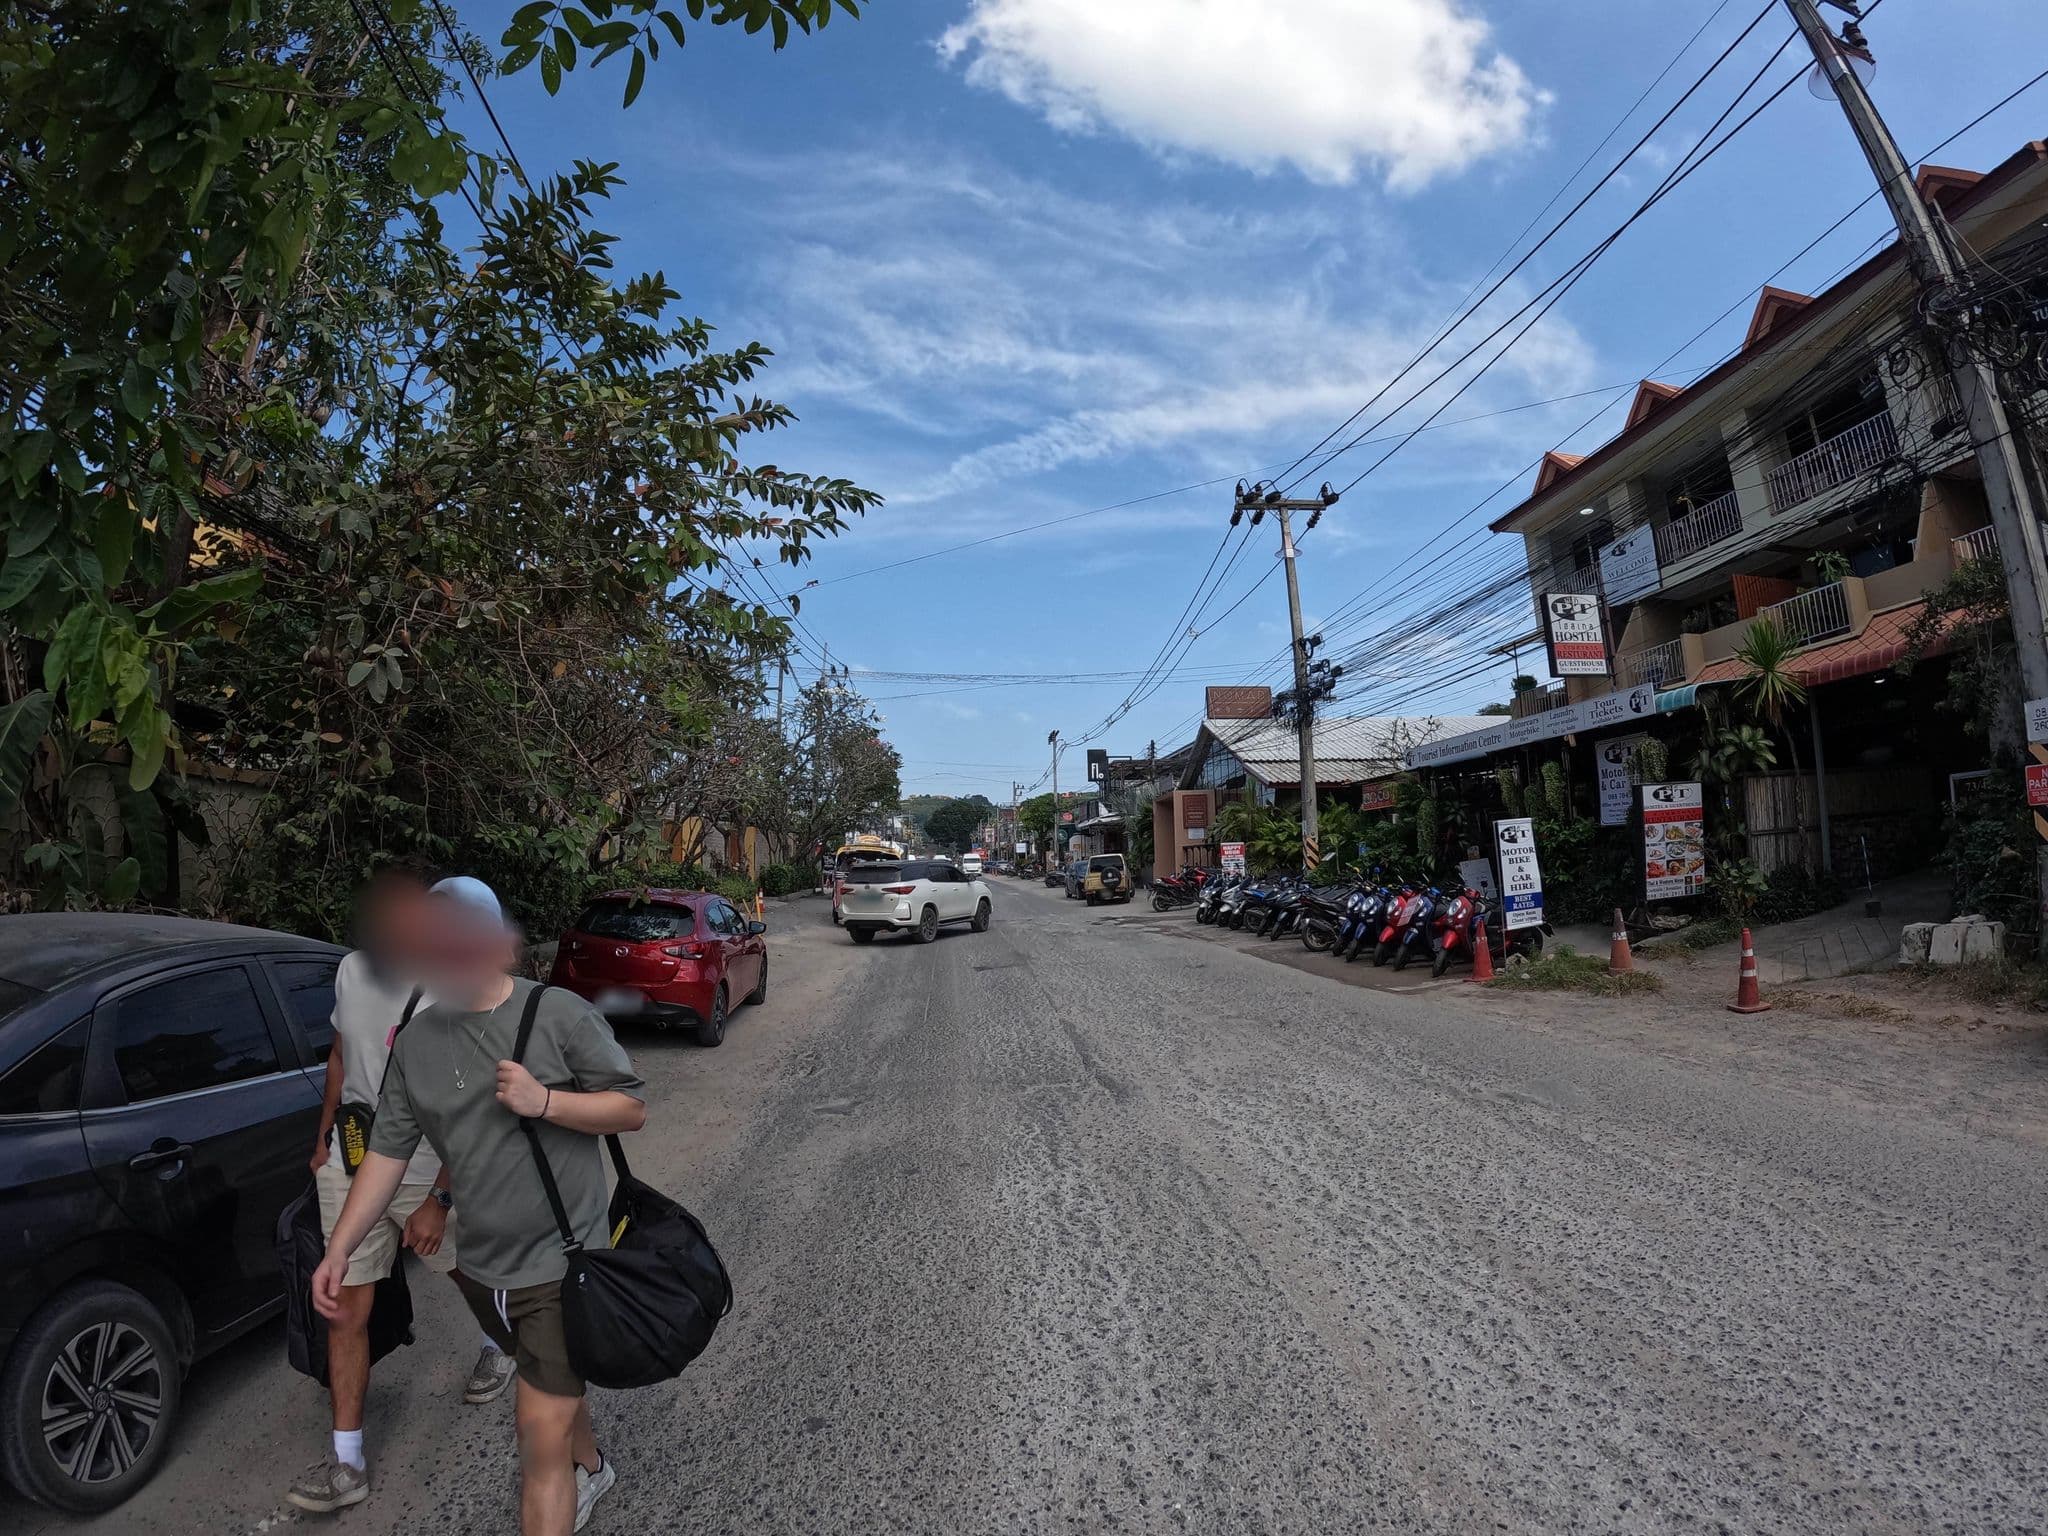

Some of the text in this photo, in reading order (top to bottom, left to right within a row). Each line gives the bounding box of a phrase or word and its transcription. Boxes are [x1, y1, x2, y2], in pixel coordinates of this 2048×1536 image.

[1607, 556, 1649, 578] WELCOME
[1555, 631, 1601, 642] HOSTEL
[1593, 698, 1617, 709] Tour
[1549, 707, 1576, 720] Laundry
[1588, 705, 1623, 719] Tickets
[1509, 726, 1540, 738] Motorbike
[1418, 734, 1502, 762] Tourist Information Centre
[1610, 778, 1626, 790] Car
[1501, 847, 1535, 857] MOTOR
[1508, 856, 1531, 865] BIKE
[1517, 865, 1525, 873] &
[1511, 874, 1532, 882] CAR
[1510, 882, 1536, 892] HIRE
[1514, 894, 1532, 903] BEST
[1512, 900, 1535, 910] RATES
[348, 1115, 358, 1148] NORTH
[356, 1128, 364, 1148] THE
